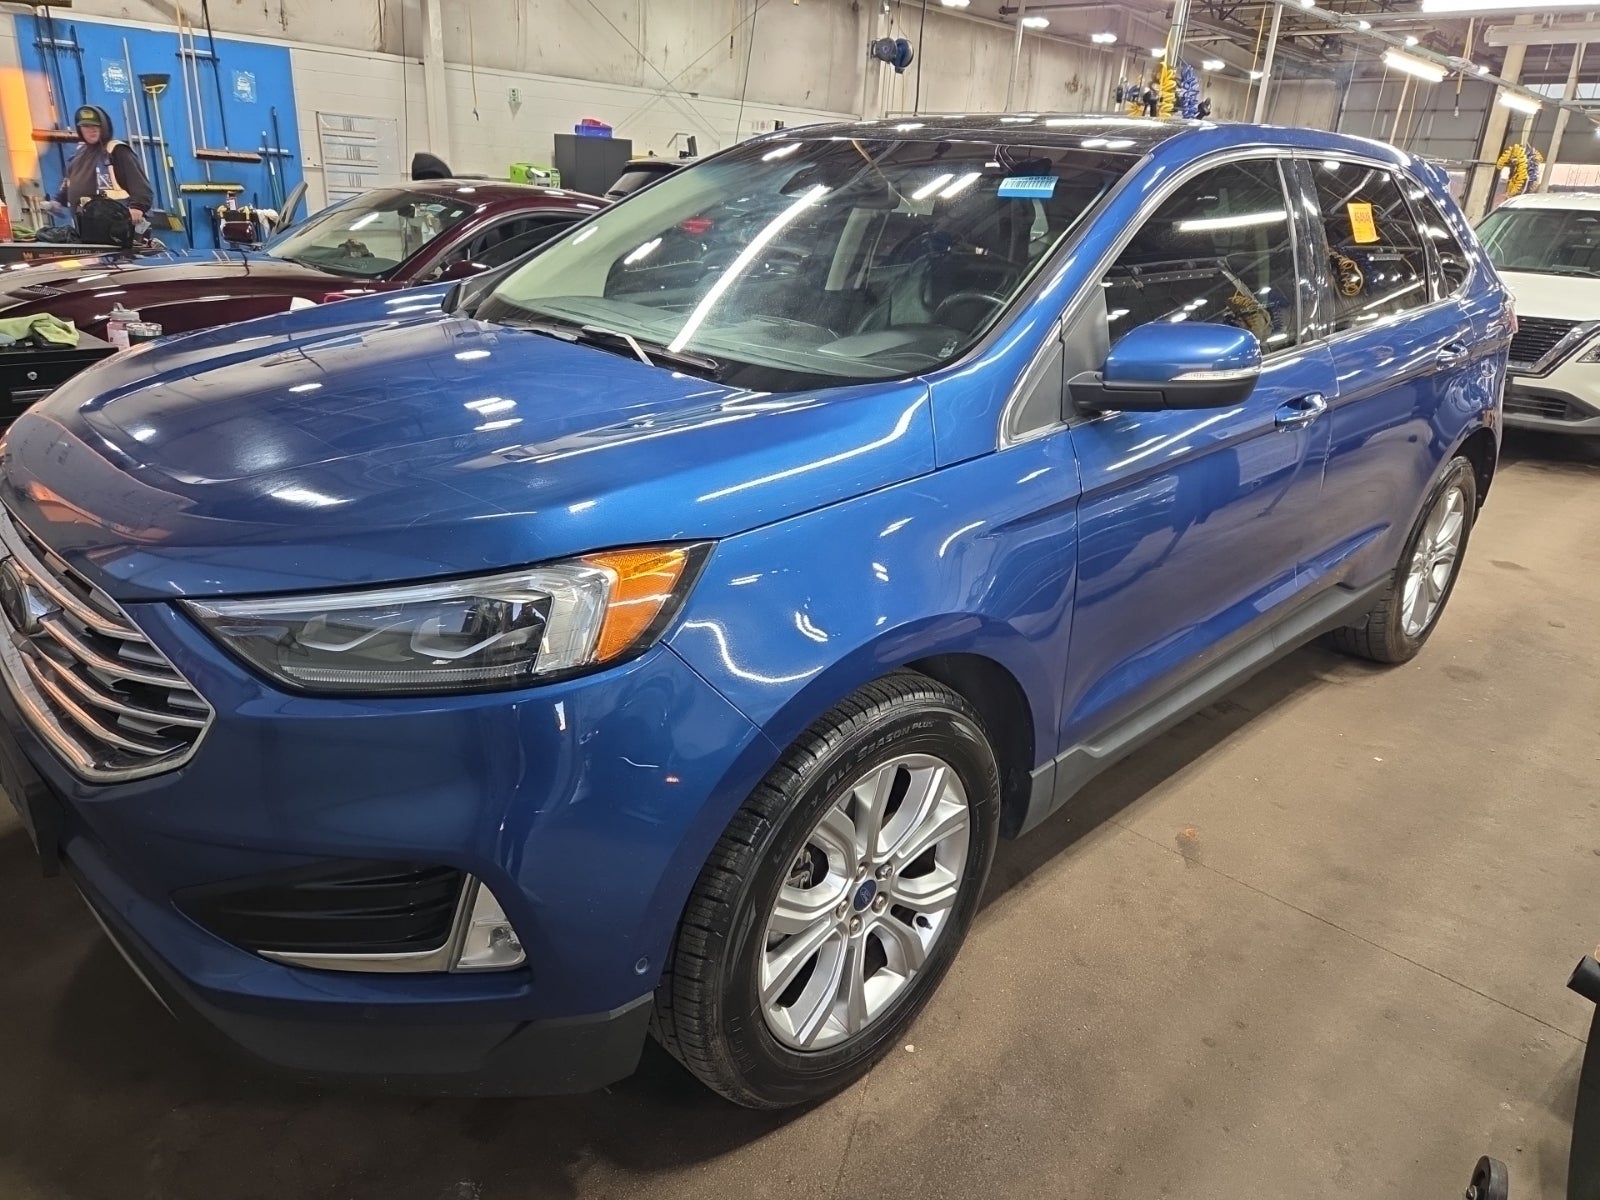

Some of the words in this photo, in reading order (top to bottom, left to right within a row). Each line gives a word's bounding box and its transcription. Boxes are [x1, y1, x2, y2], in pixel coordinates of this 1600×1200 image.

[825, 763, 853, 792] ALL
[856, 726, 910, 762] SEASON
[912, 720, 934, 730] PLUS
